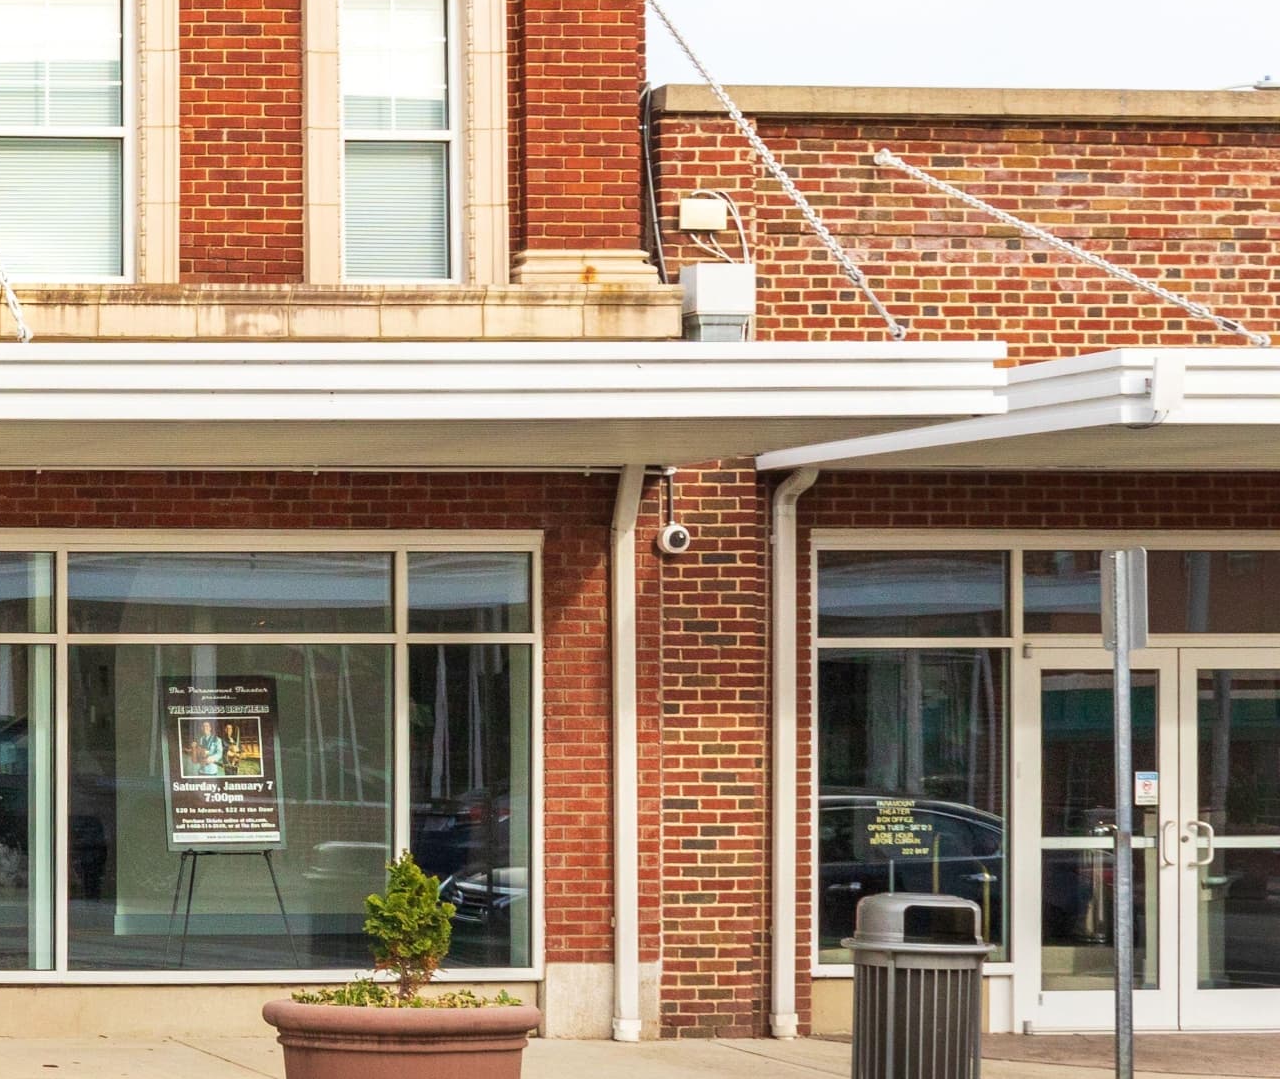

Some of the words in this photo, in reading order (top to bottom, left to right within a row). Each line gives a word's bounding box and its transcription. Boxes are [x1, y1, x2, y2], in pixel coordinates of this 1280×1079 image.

[173, 782, 220, 792] Saturday,
[224, 781, 263, 792] January
[266, 781, 273, 790] 7
[204, 793, 243, 803] 7:00pm
